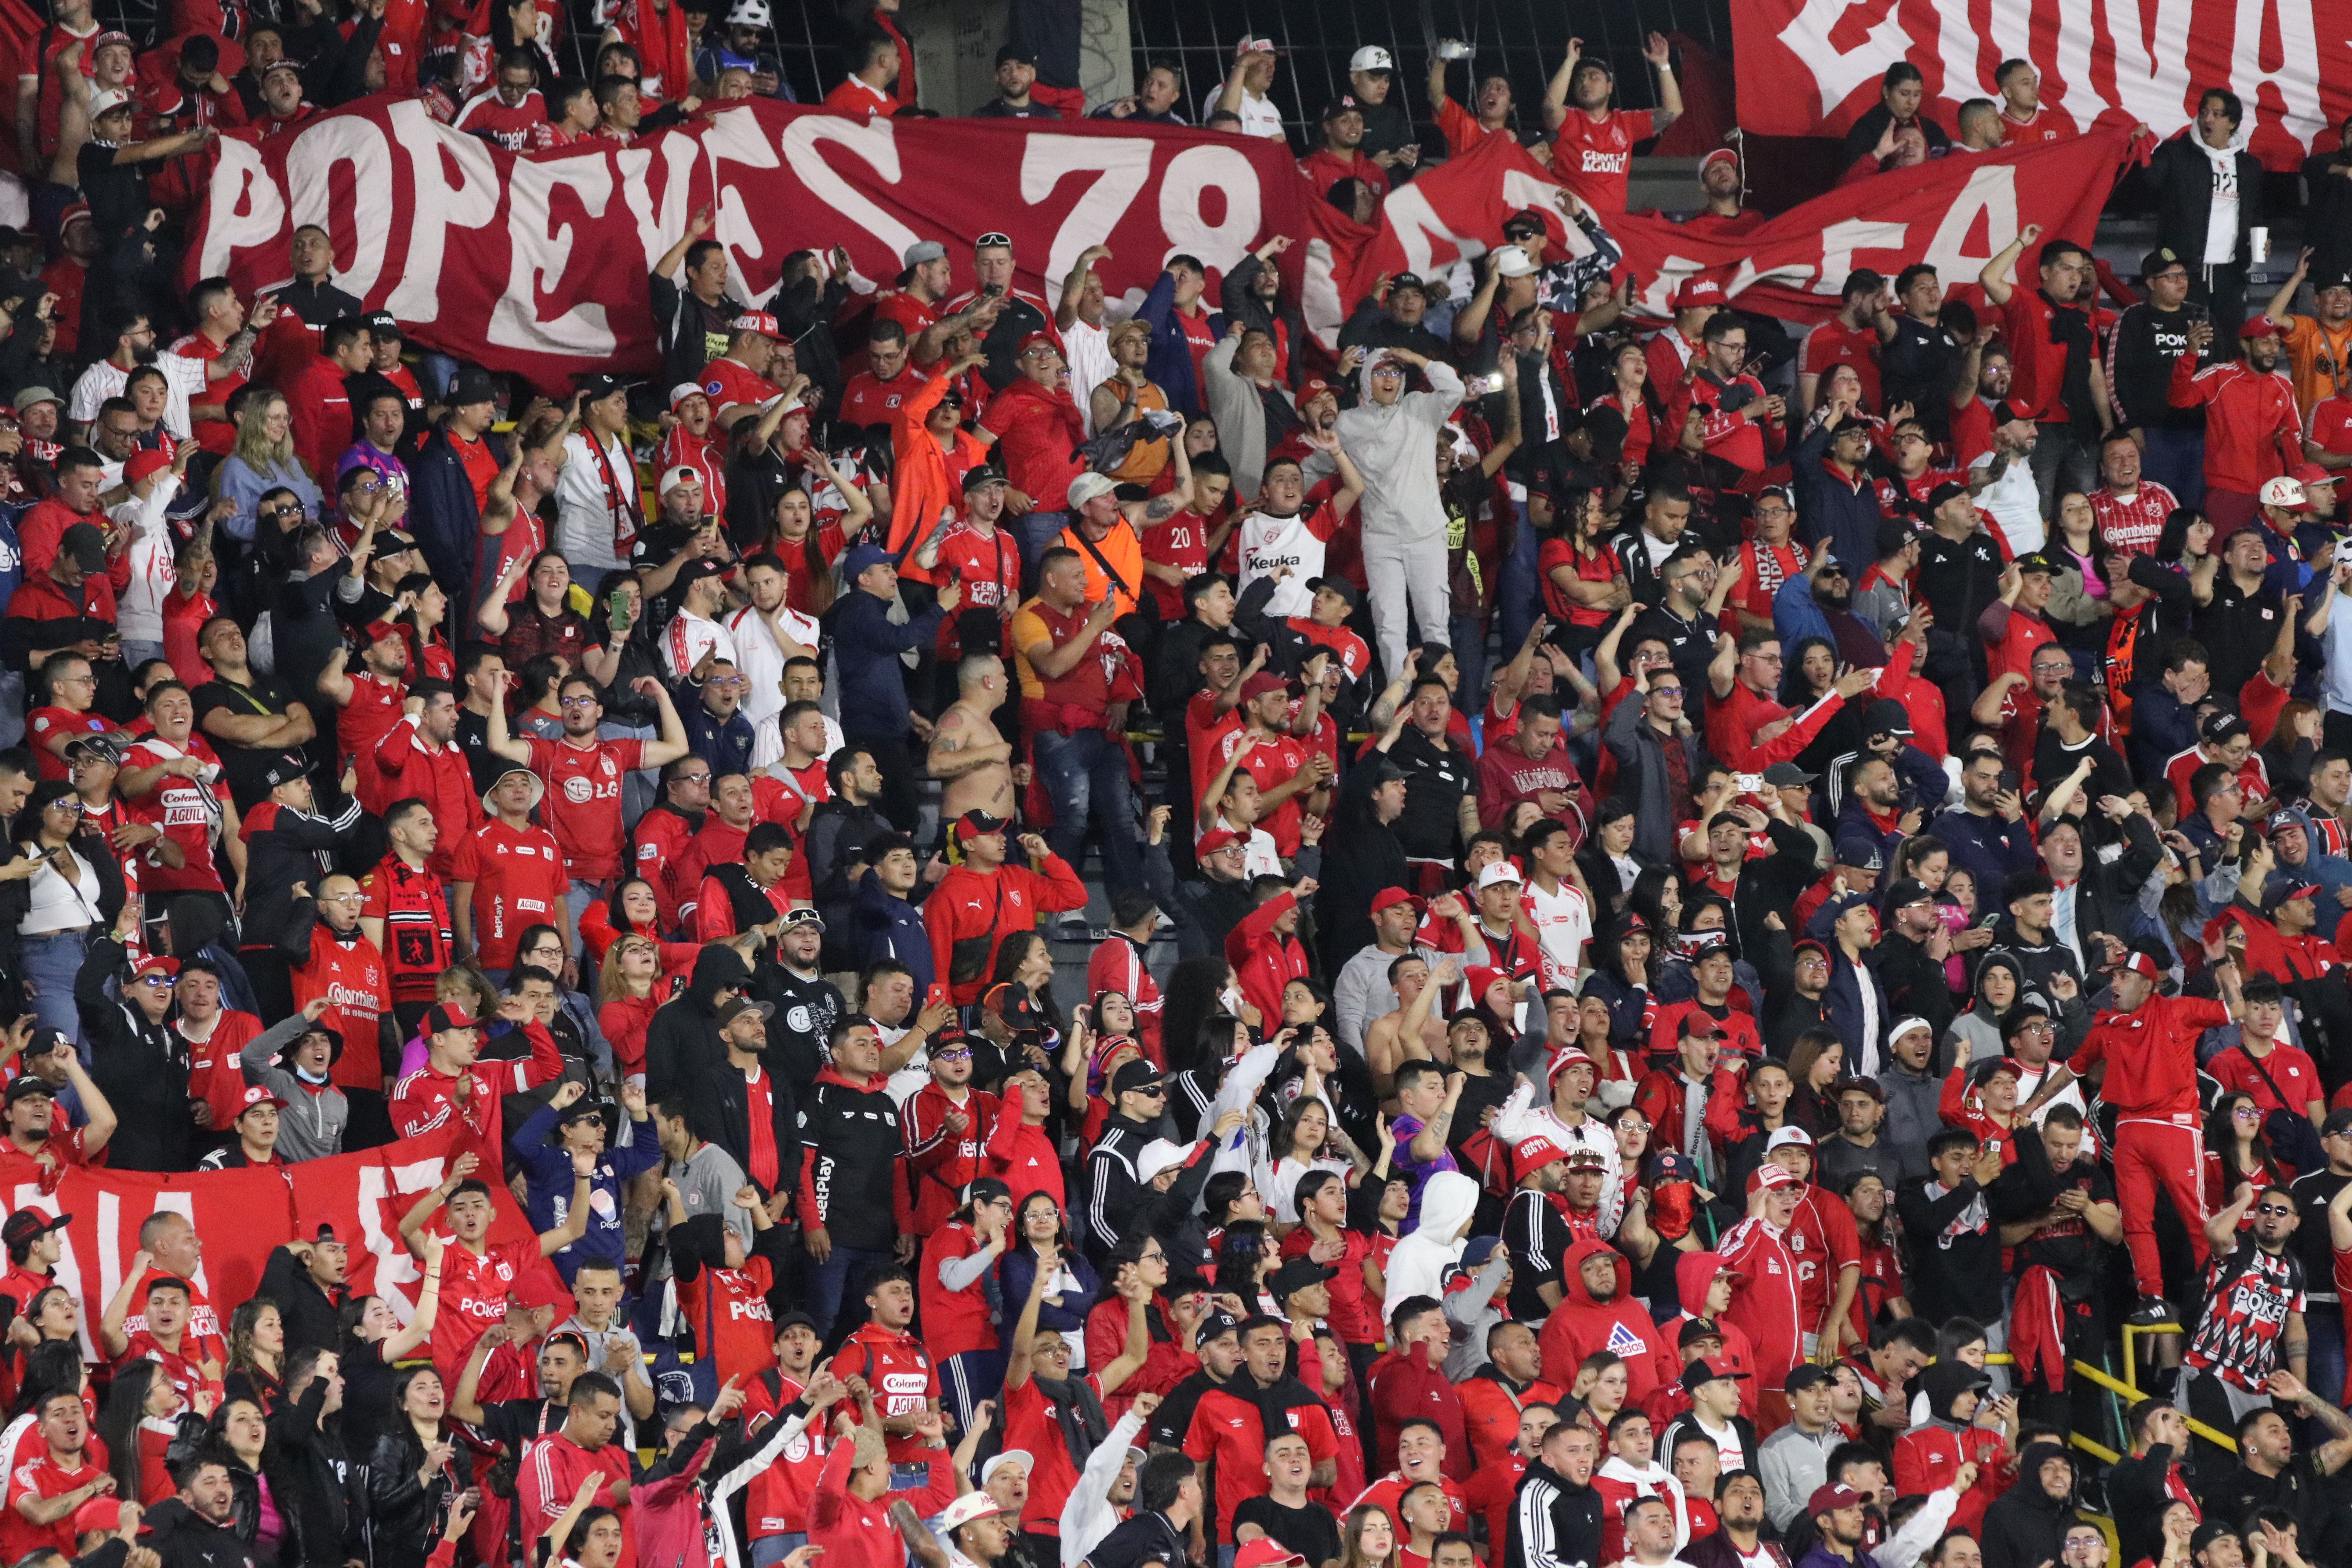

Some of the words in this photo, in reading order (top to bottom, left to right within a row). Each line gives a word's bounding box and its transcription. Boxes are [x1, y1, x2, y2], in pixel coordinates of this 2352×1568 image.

[1020, 132, 1262, 319] 78
[1171, 527, 1190, 549] 20
[2103, 524, 2162, 543] Colombiana
[1248, 554, 1301, 571] Keuka
[164, 792, 203, 803] Colan
[596, 780, 618, 799] LG
[519, 900, 543, 912] AGUILA
[493, 905, 503, 938] BetPlay
[345, 1006, 354, 1016] la
[1521, 1138, 1549, 1159] SECTA
